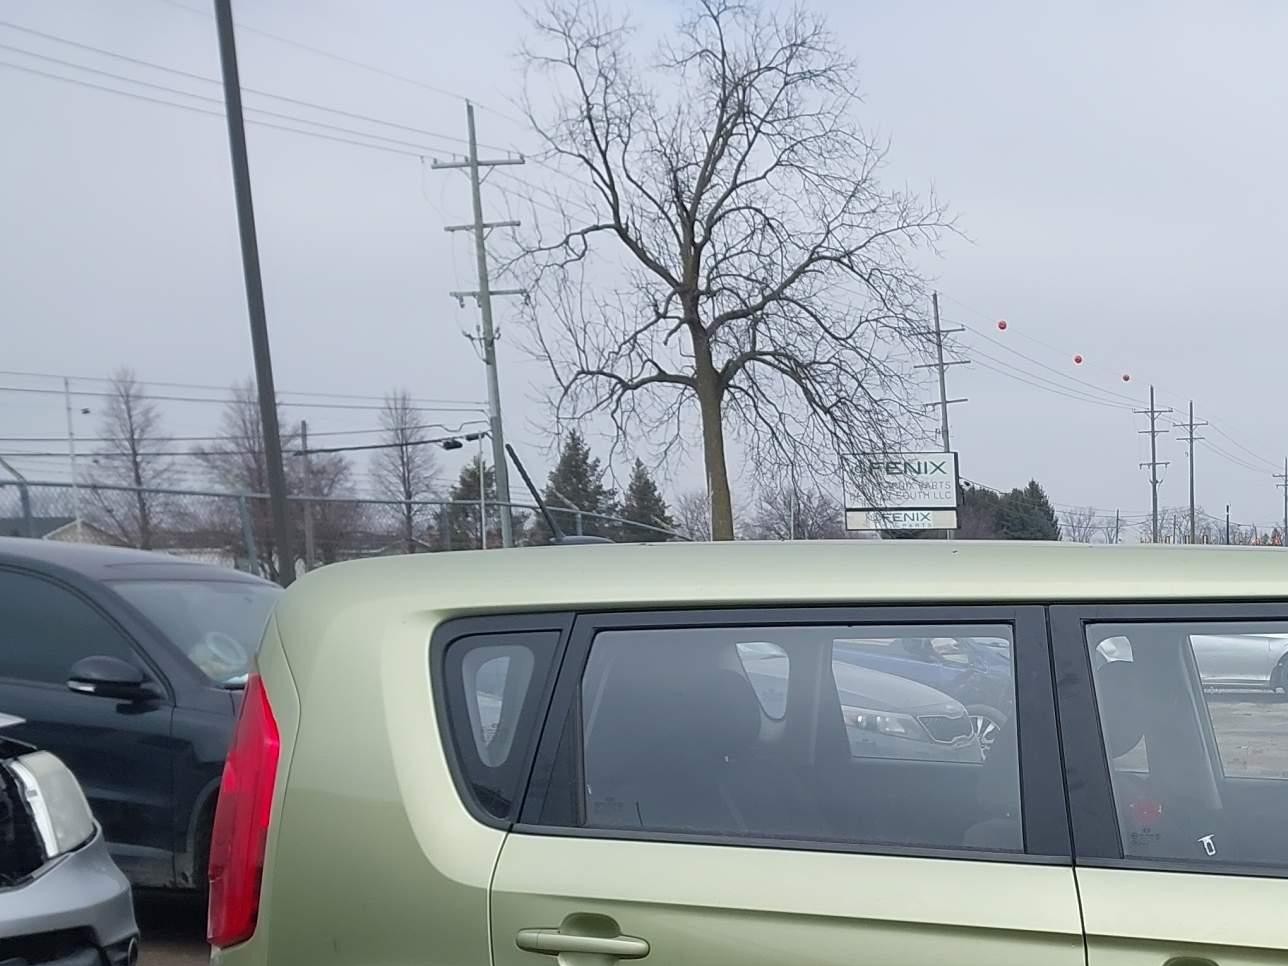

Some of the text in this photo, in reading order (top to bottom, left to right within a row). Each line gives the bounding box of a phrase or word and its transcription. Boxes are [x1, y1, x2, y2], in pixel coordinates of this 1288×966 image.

[870, 461, 947, 475] FENIX
[933, 491, 952, 500] LLC
[881, 512, 931, 522] FENIX
